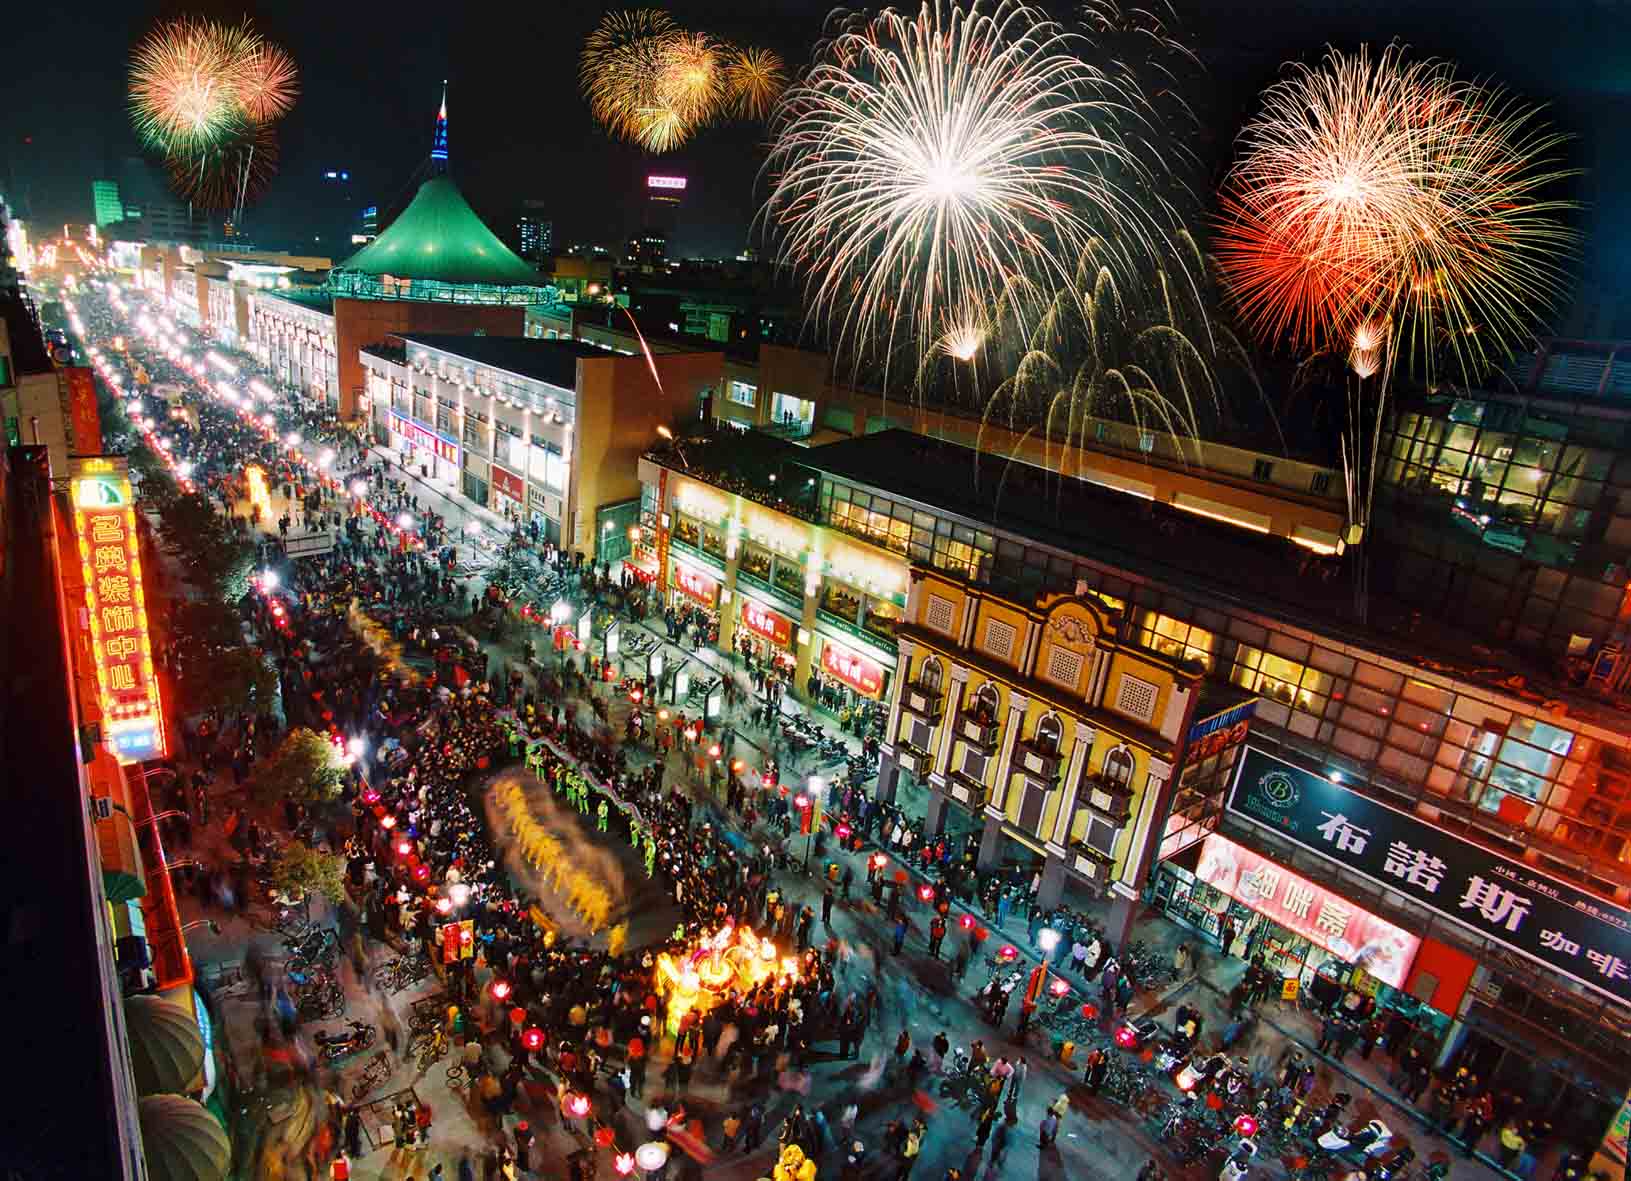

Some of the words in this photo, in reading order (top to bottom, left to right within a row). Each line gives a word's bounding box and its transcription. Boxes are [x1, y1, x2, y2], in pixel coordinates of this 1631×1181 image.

[1316, 810, 1533, 932] 布諾斯
[1539, 928, 1630, 980] 咖啡
